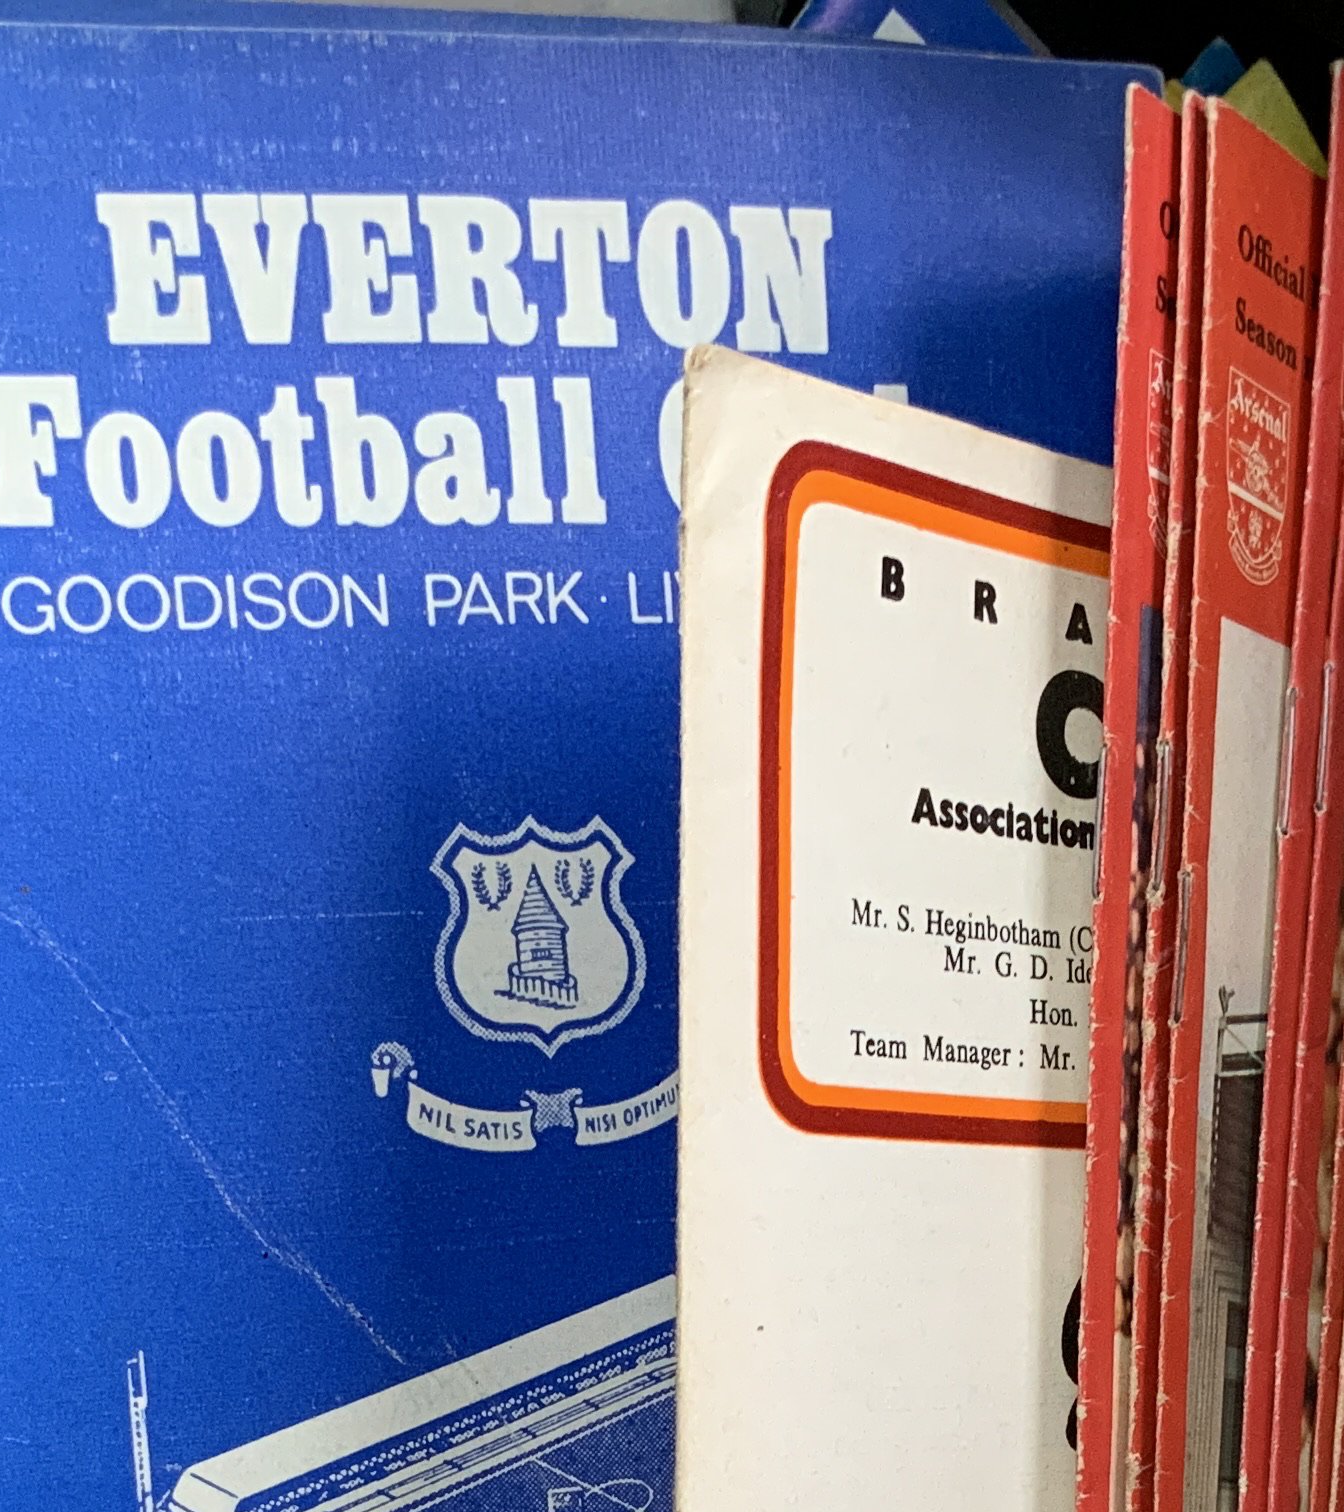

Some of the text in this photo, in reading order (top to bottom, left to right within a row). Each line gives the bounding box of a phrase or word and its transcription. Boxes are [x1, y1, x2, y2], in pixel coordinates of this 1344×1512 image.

[95, 191, 834, 355] EVERTON
[1238, 224, 1307, 303] Official
[1235, 297, 1298, 371] Season
[0, 572, 387, 635] GOODISON
[425, 570, 590, 627] PARK
[851, 898, 888, 929] Mr.
[896, 904, 917, 934] S.
[925, 908, 1061, 950] Heginbotham
[943, 947, 981, 976] Mr.
[995, 952, 1018, 979] G.
[1030, 957, 1054, 983] D.
[1029, 1000, 1077, 1028] Hon.
[850, 1031, 907, 1063] Team
[1040, 1043, 1076, 1072] Mr.
[418, 1103, 456, 1134] NIL
[464, 1118, 523, 1139] SATIS
[585, 1110, 616, 1134] NISI
